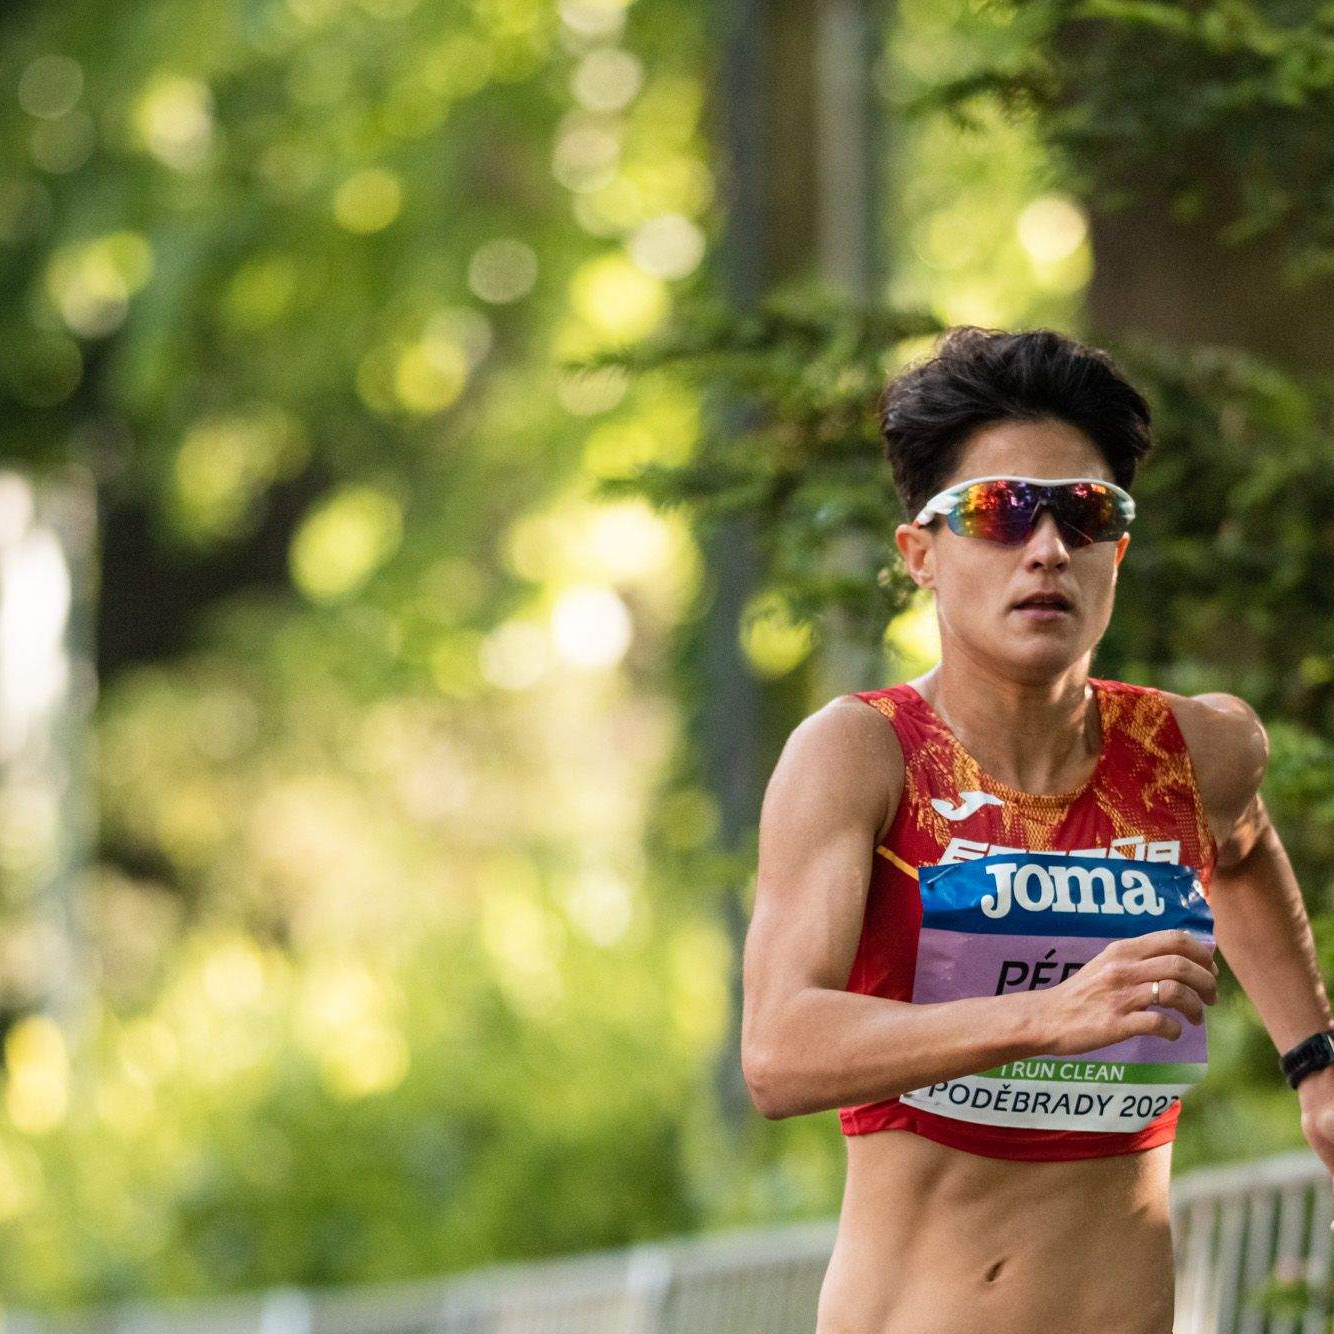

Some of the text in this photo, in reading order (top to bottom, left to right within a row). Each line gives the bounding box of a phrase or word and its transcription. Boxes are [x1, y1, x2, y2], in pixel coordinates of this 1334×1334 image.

[1012, 1060, 1056, 1079] RUN
[1060, 1063, 1125, 1081] CLEAN
[928, 1082, 1179, 1118] PODĚBRADY 202
